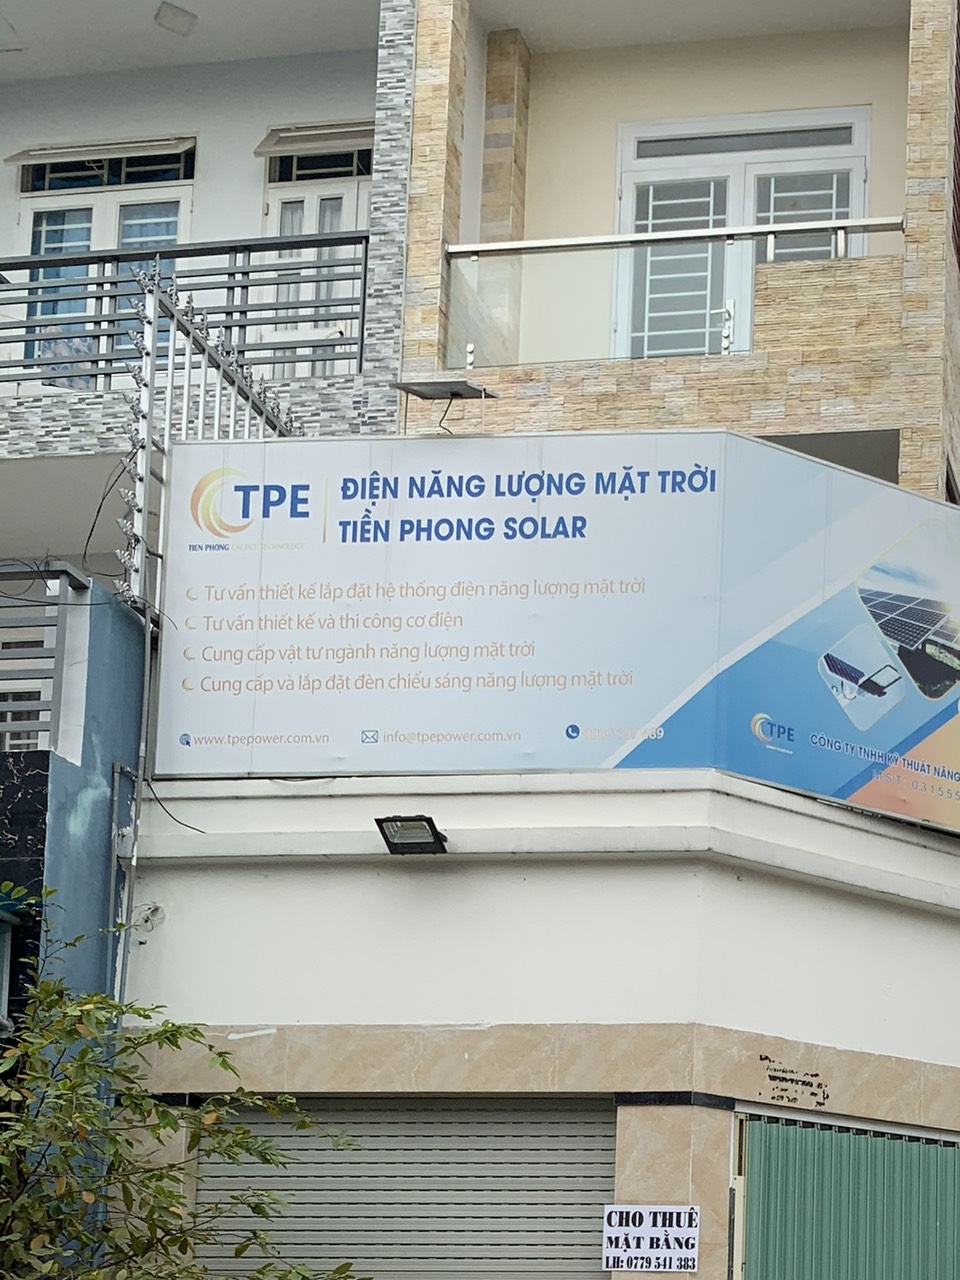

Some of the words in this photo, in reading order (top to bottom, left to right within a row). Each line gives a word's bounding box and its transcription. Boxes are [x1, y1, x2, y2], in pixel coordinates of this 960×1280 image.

[341, 470, 399, 506] ĐIỆN
[408, 469, 486, 498] NĂNG
[495, 470, 586, 503] LƯỢNG
[595, 465, 650, 501] MẶT
[658, 463, 716, 493] TRỜI
[234, 484, 310, 519] TPE
[339, 508, 390, 543] TIỀN
[399, 518, 496, 542] PHONG
[503, 515, 587, 540] SOLAR
[204, 585, 226, 601] Tư
[228, 583, 255, 601] vấn
[259, 582, 295, 601] thiết
[298, 582, 317, 600] kế
[319, 583, 344, 603] lắp
[346, 582, 372, 602] đặt
[376, 582, 395, 602] hệ
[399, 580, 447, 602] thống
[450, 580, 485, 600] điện
[489, 580, 529, 600] năng
[533, 579, 579, 599] lượng
[584, 579, 615, 598] mặt
[619, 577, 645, 595] trời
[203, 615, 225, 631] Tư
[226, 613, 254, 631] vấn
[257, 613, 293, 631] thiết
[297, 612, 316, 630] kế
[318, 612, 336, 629] và
[339, 612, 359, 629] thi
[363, 612, 403, 632] công
[406, 614, 426, 629] cơ
[428, 611, 463, 631] điện
[201, 646, 244, 666] Cung
[247, 643, 275, 665] cấp
[278, 644, 301, 665] vật
[306, 645, 325, 660] tư
[325, 643, 376, 664] ngành
[379, 645, 420, 663] năng
[424, 642, 470, 662] lượng
[474, 641, 505, 661] mặt
[508, 640, 535, 657] trời
[200, 676, 242, 696] Cung
[245, 673, 274, 695] cấp
[277, 675, 295, 691] và
[298, 674, 322, 694] lắp
[325, 674, 351, 694] đặt
[354, 673, 385, 690] đèn
[388, 671, 431, 689] chiếu
[435, 673, 472, 693] sáng
[476, 672, 517, 692] năng
[521, 671, 567, 691] lượng
[571, 670, 602, 690] mặt
[606, 670, 633, 686] trời
[193, 732, 329, 747] www.tpepower.com.vn
[383, 729, 521, 744] info@tpepower.com.vn
[767, 722, 795, 742] TPE
[810, 733, 842, 752] CÔNG
[844, 742, 857, 756] TY
[858, 746, 884, 764] TNHH
[901, 756, 931, 776] THUẬT
[606, 1211, 644, 1228] CHO
[649, 1207, 698, 1228] THUÊ
[606, 1232, 644, 1253] MẶT
[649, 1230, 696, 1250] BẰNG
[605, 1256, 624, 1269] LH:
[626, 1256, 652, 1269] 0779
[654, 1256, 672, 1270] 541
[676, 1257, 696, 1270] 383
